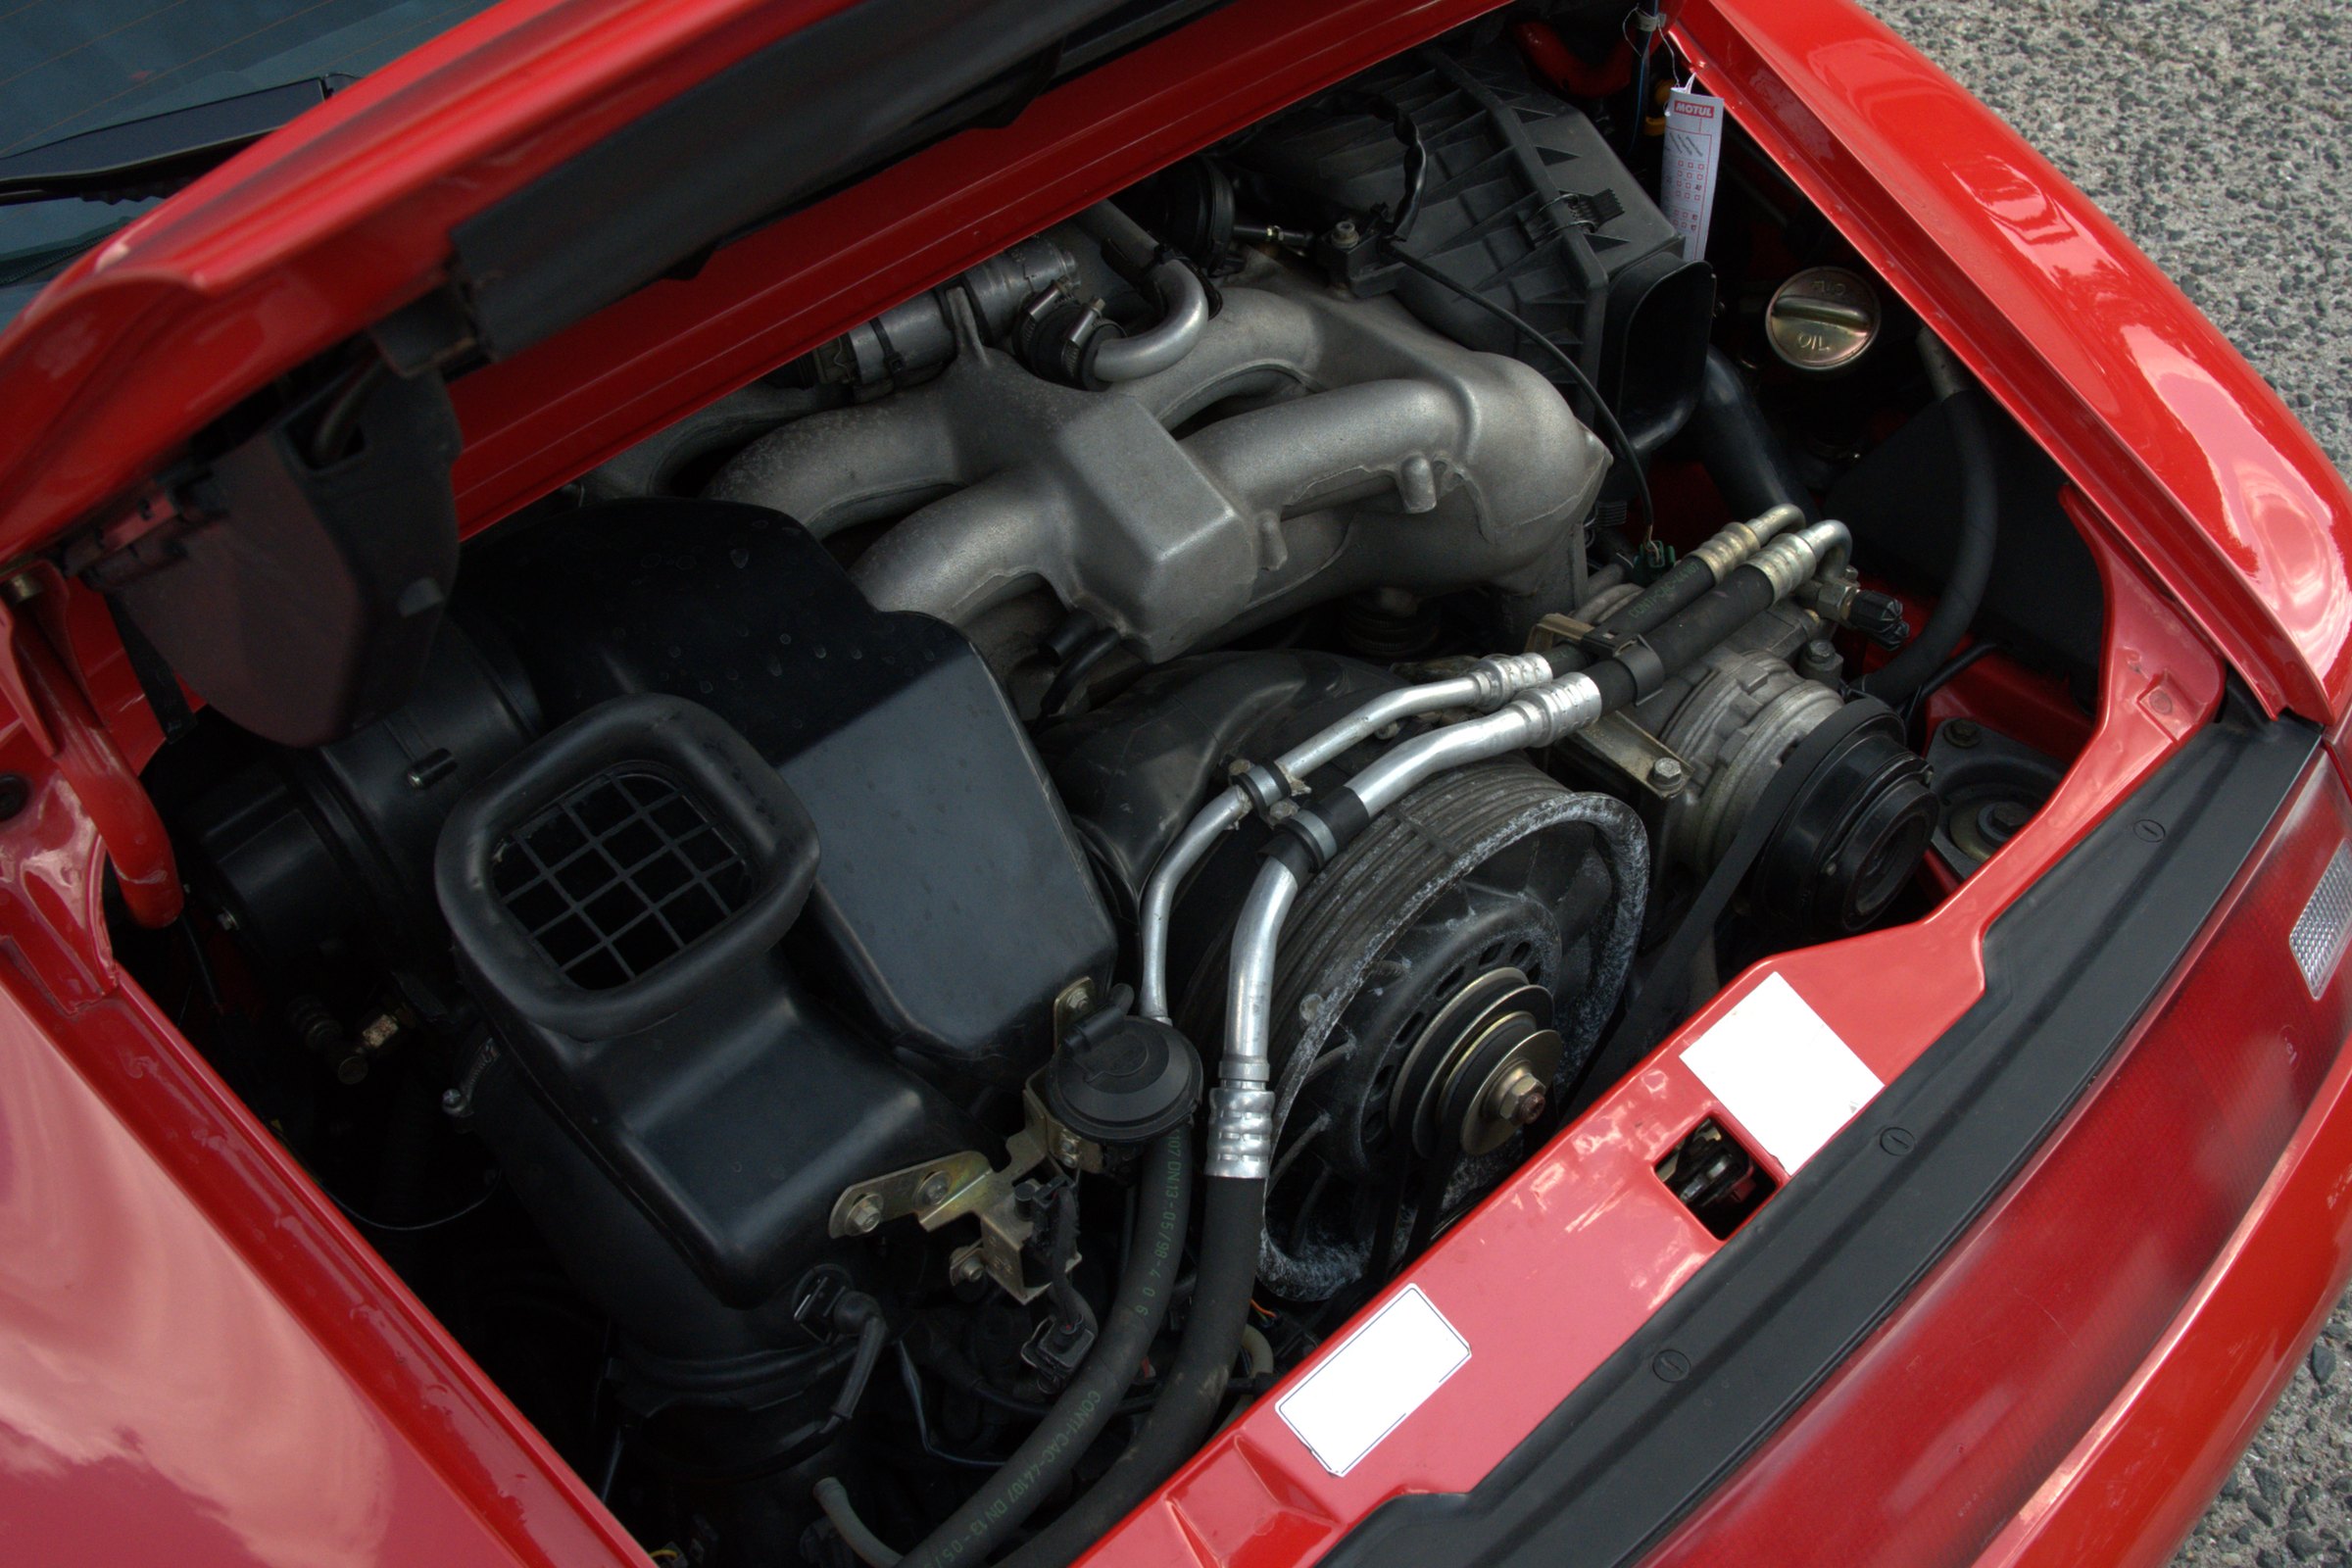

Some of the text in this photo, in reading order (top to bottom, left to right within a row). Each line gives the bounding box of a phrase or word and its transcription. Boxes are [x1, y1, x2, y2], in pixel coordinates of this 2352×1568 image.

[1676, 102, 1712, 117] MOTUL
[1798, 333, 1831, 351] OIL
[1166, 1128, 1182, 1156] 107
